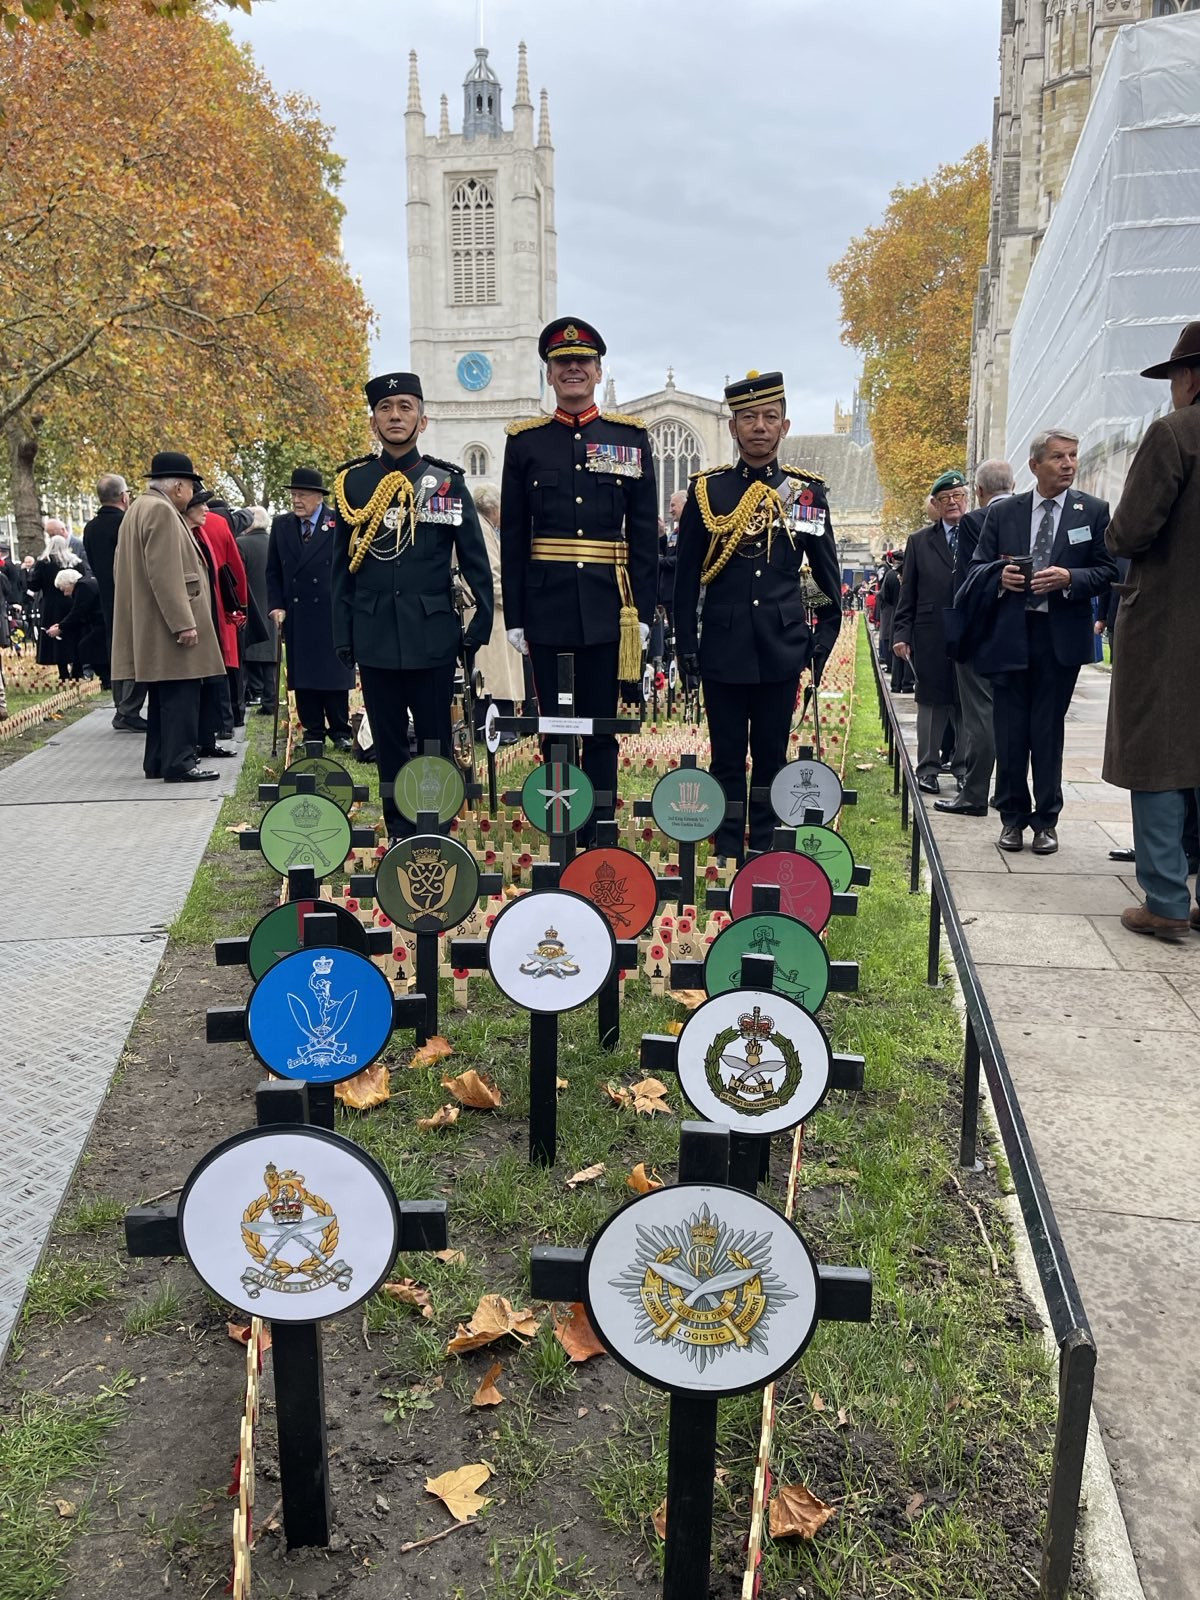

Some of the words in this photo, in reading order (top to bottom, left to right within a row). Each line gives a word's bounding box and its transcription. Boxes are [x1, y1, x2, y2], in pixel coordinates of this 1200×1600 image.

[420, 893, 434, 909] 7
[734, 1081, 767, 1092] UBIQUE
[645, 1290, 665, 1322] GURKHA
[677, 1328, 726, 1342] LOGISTIC
[737, 1296, 761, 1330] REGIMENT
[677, 1305, 709, 1320] QUEEN'S
[711, 1308, 728, 1320] OWN
